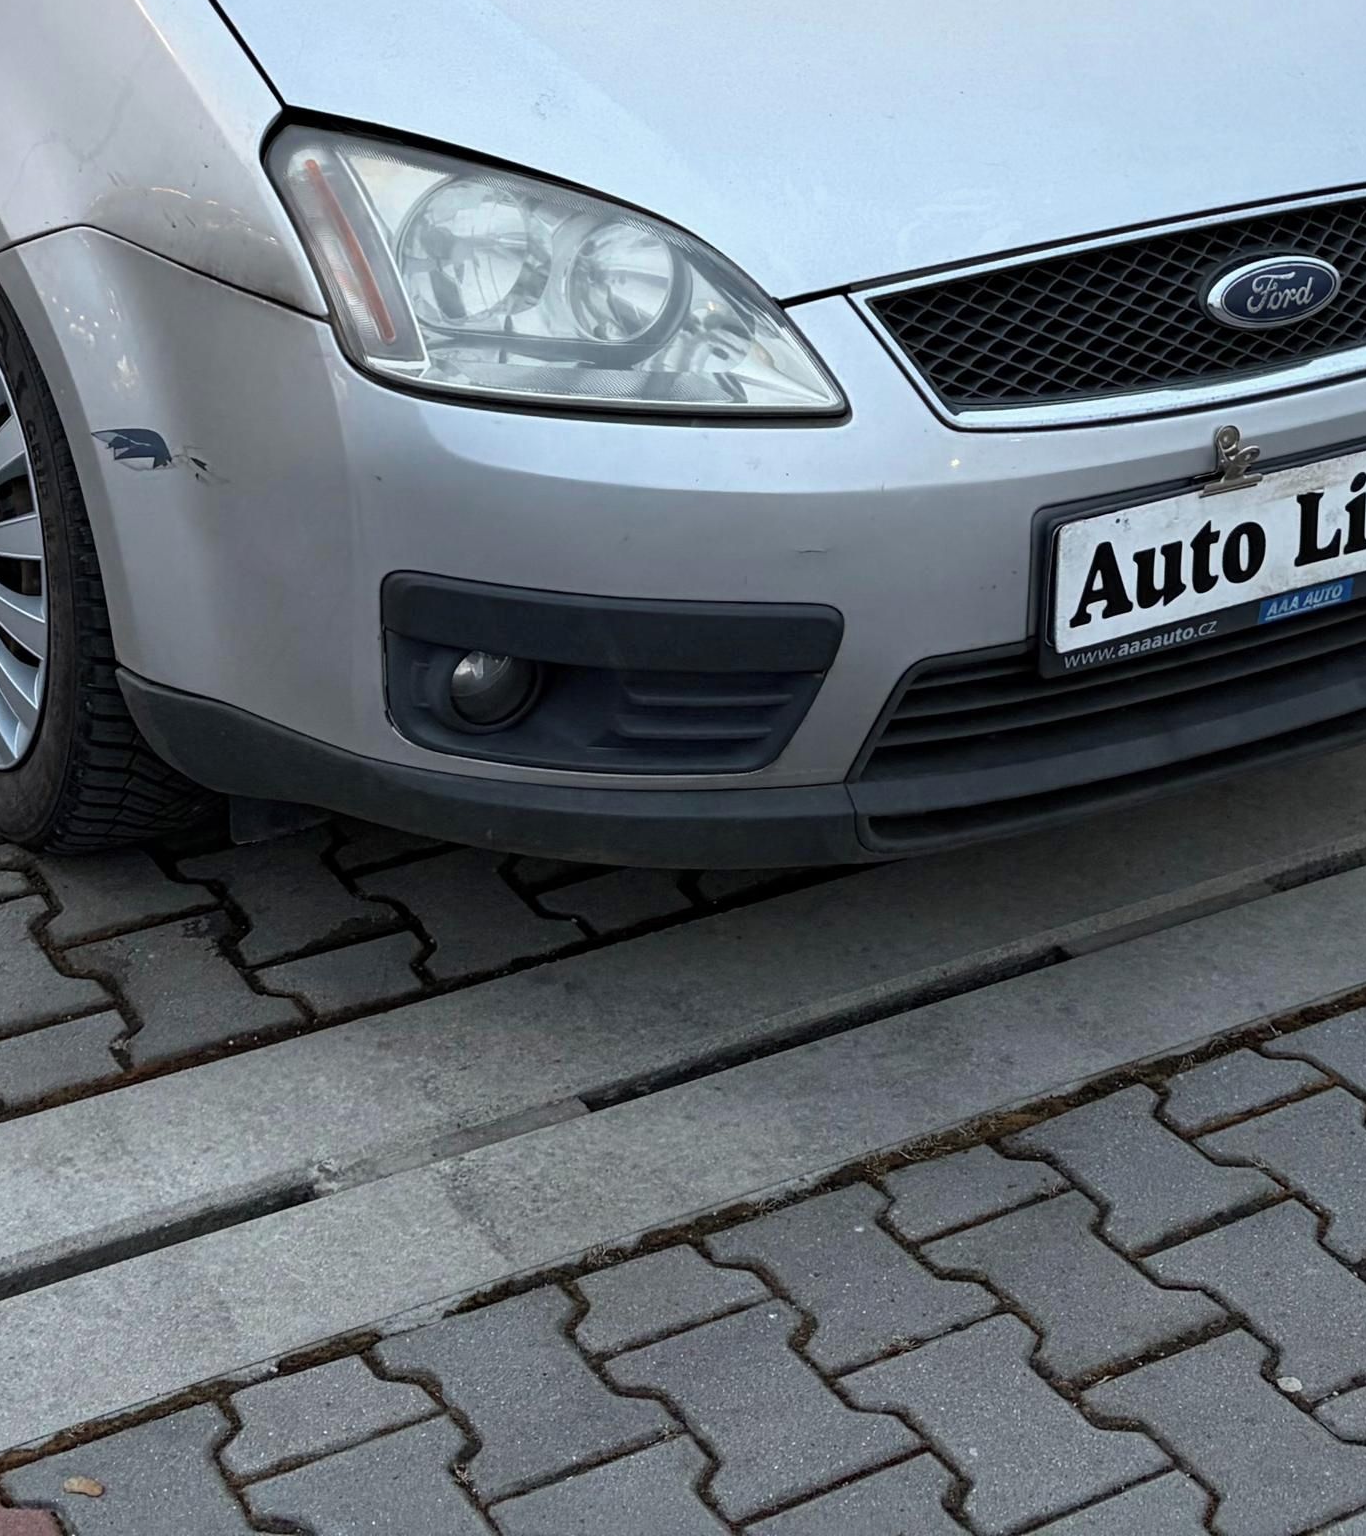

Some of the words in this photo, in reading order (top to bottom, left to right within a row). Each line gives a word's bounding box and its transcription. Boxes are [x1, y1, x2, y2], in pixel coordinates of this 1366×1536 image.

[1246, 271, 1315, 314] Ford
[1069, 520, 1266, 628] Auto
[1267, 595, 1300, 617] AAA
[1303, 584, 1343, 610] AUTO
[1064, 620, 1218, 669] www.aaaauto.cz
